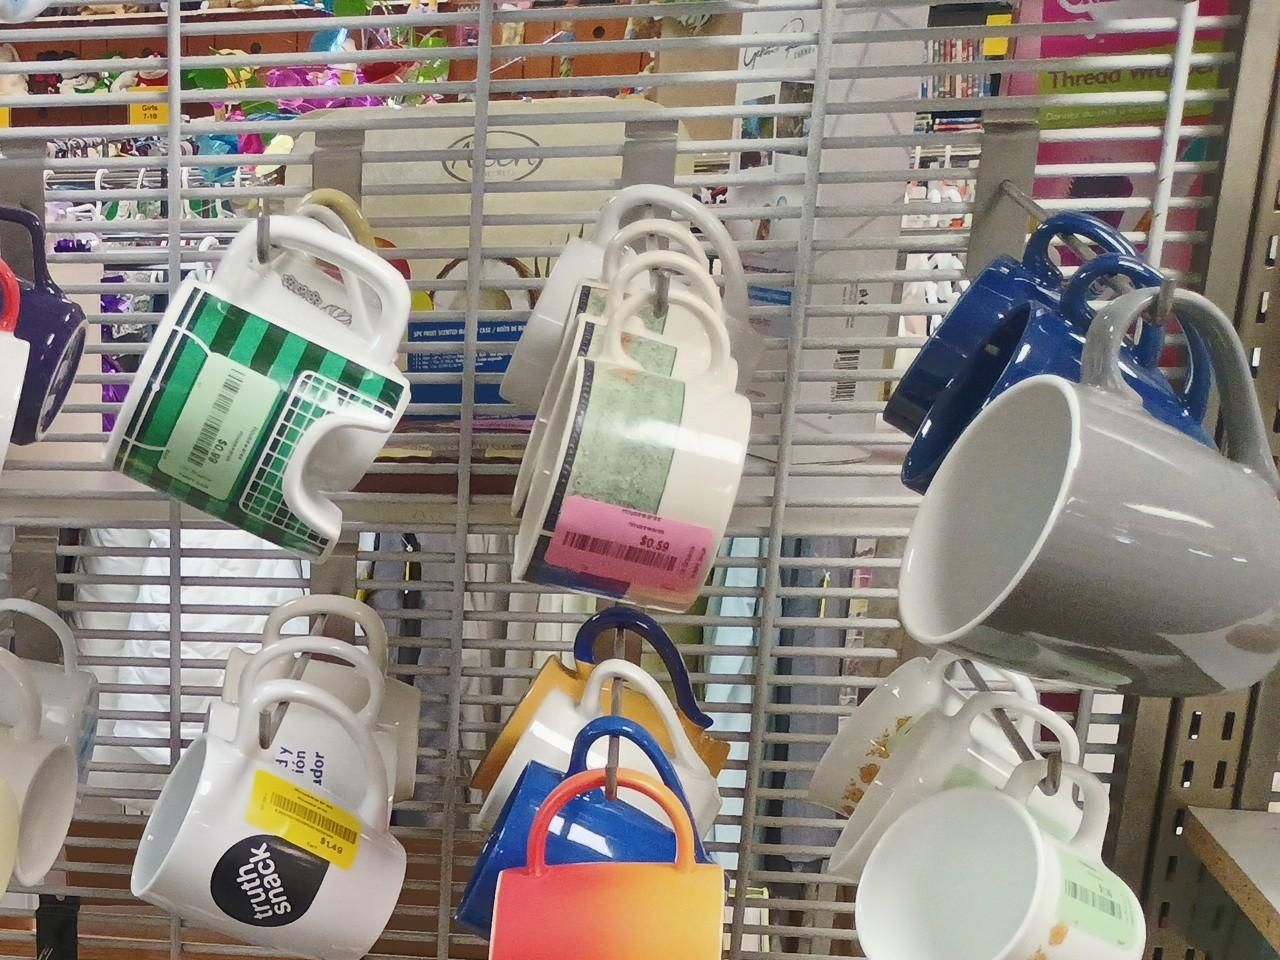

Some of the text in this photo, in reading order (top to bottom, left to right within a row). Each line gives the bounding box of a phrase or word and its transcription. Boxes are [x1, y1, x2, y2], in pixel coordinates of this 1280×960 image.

[142, 104, 158, 112] Girls
[207, 438, 228, 465] $0.99
[639, 534, 670, 552] $0.59
[320, 837, 344, 855] $1.49
[251, 842, 292, 915] snack
[236, 863, 273, 920] truth
